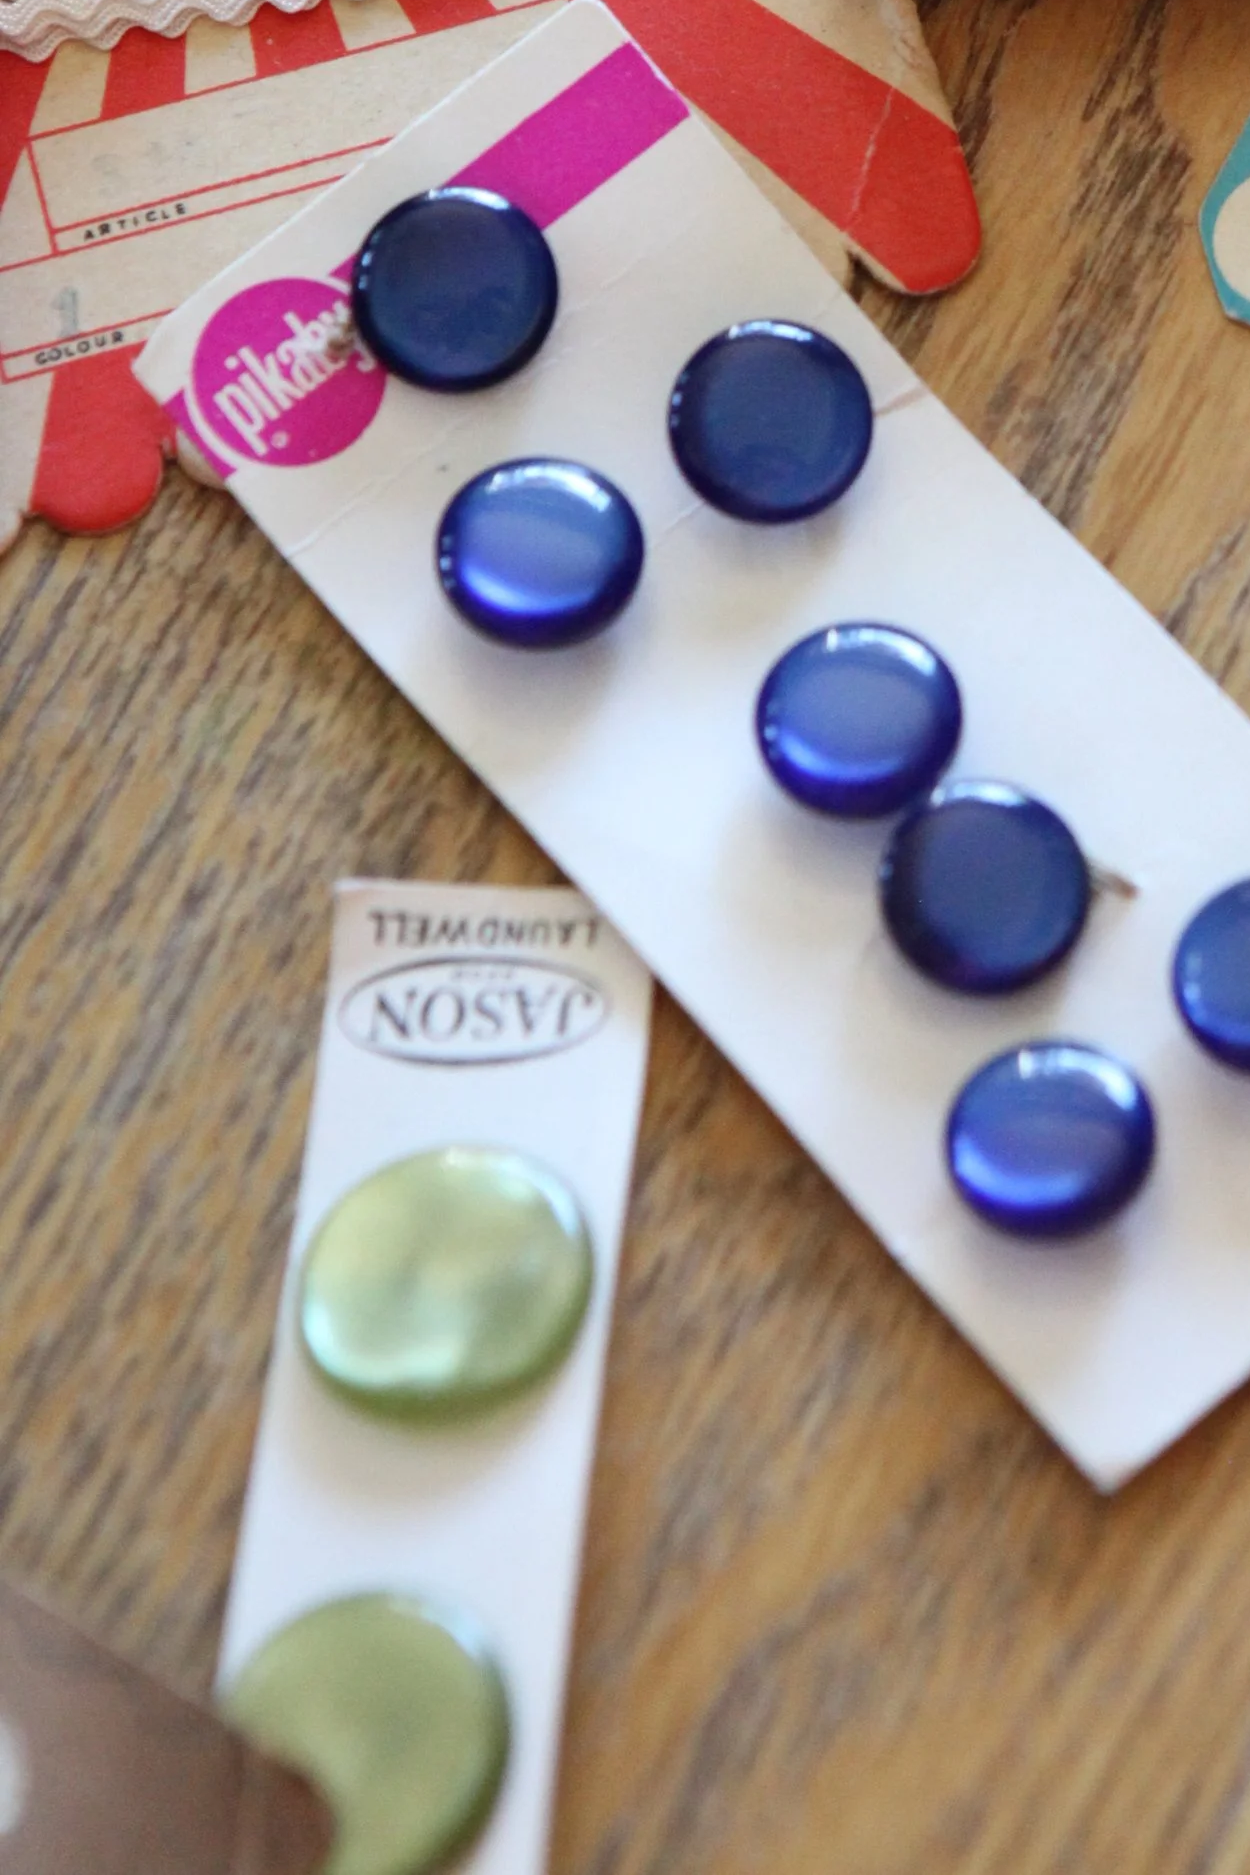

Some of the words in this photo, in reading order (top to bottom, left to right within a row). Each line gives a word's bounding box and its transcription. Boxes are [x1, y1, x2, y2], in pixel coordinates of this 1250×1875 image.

[82, 202, 189, 242] ARTICLE
[34, 330, 126, 367] COLOUR
[365, 986, 594, 1044] JASON
